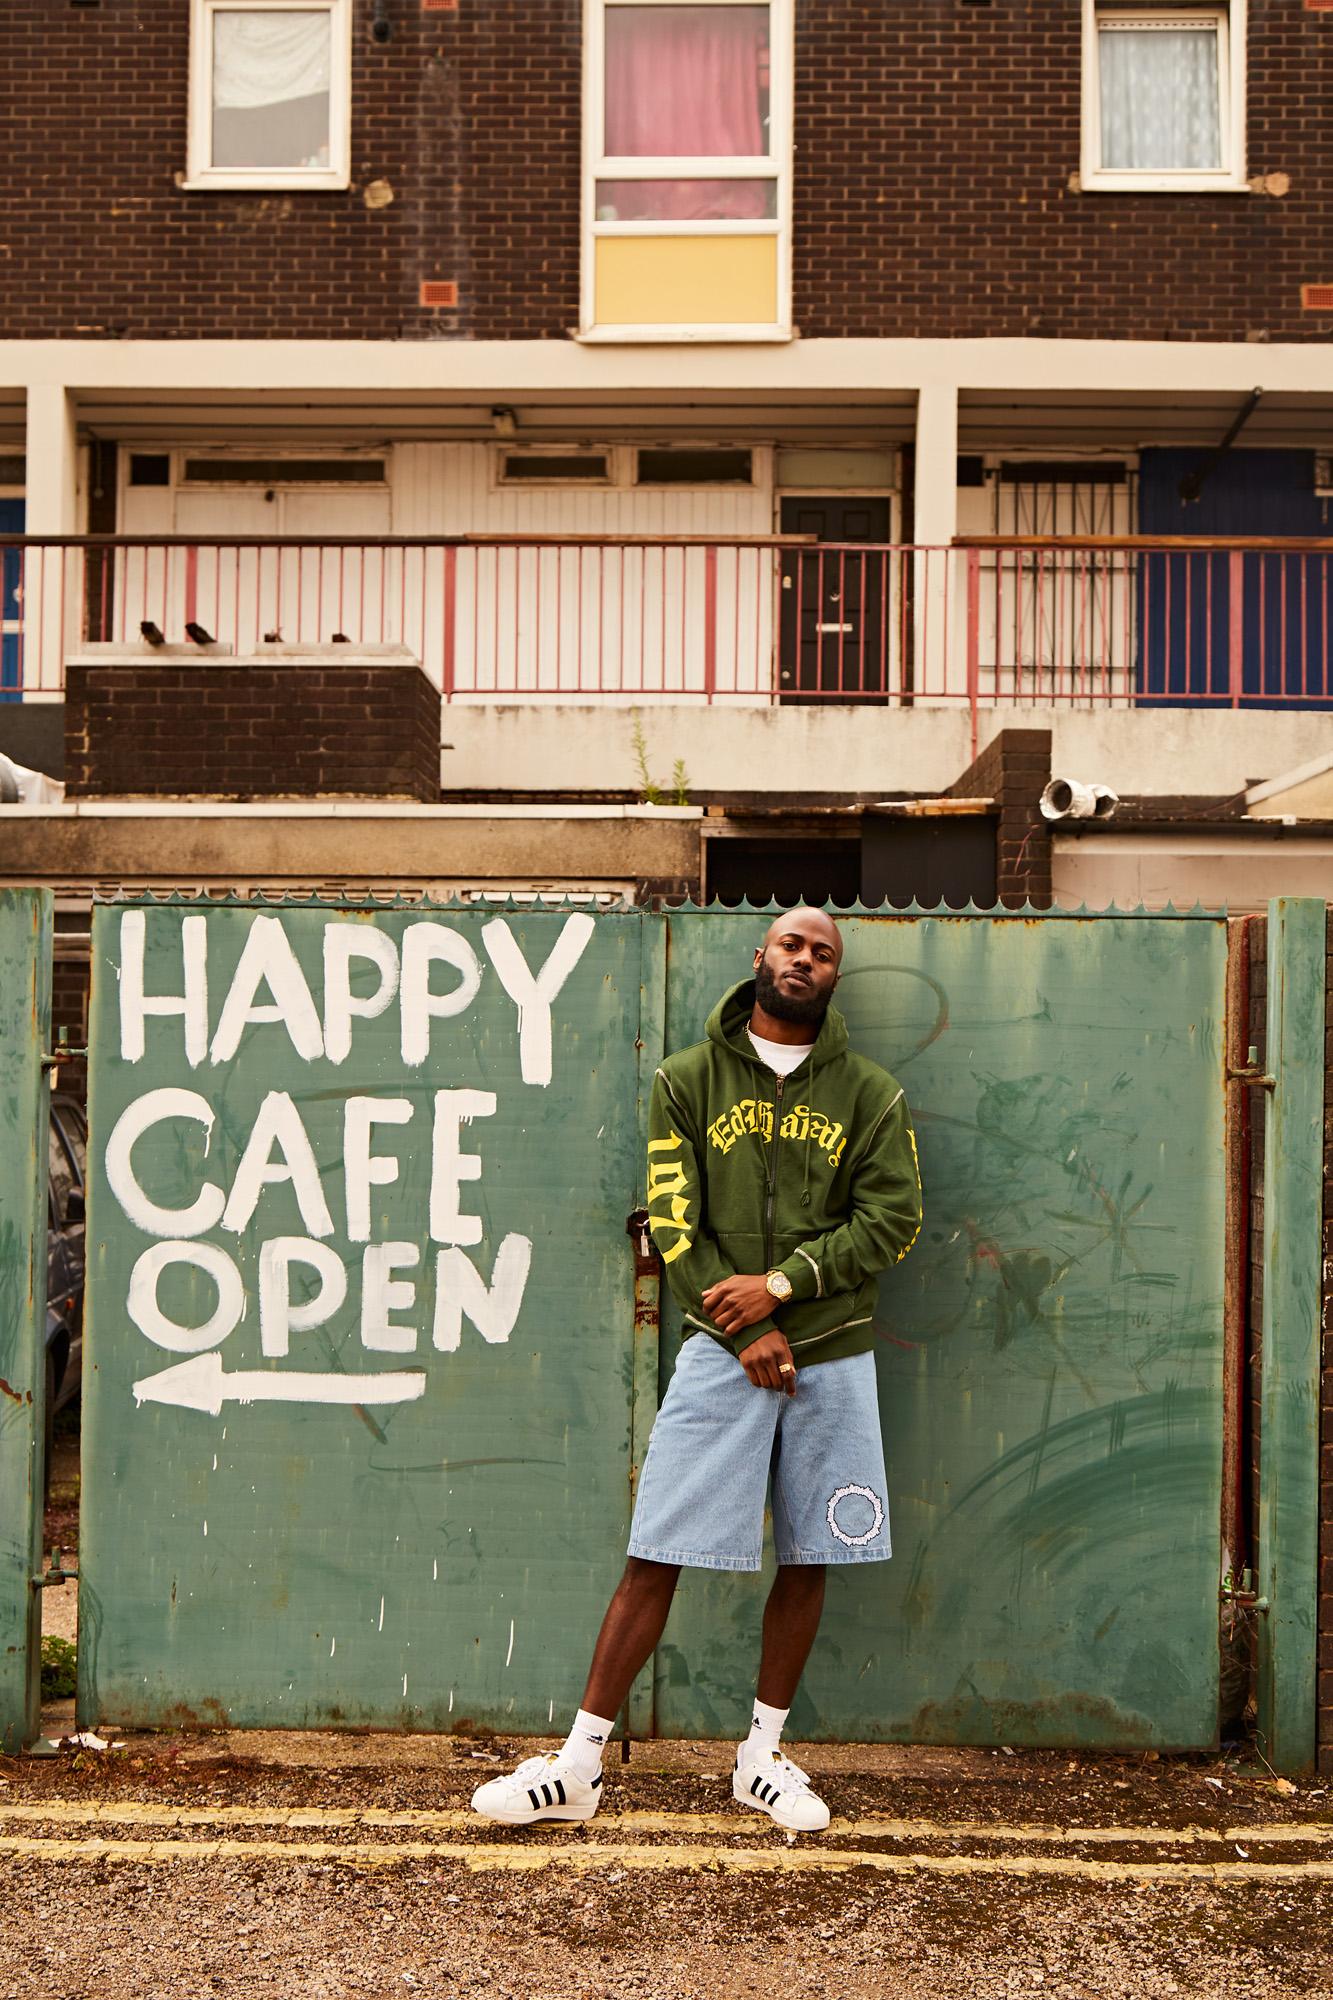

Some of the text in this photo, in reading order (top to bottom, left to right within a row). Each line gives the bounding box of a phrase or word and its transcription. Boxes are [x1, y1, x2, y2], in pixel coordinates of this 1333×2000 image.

[120, 910, 595, 1086] HAPPY
[105, 1088, 497, 1246] CAFE
[127, 1232, 532, 1357] OPEN
